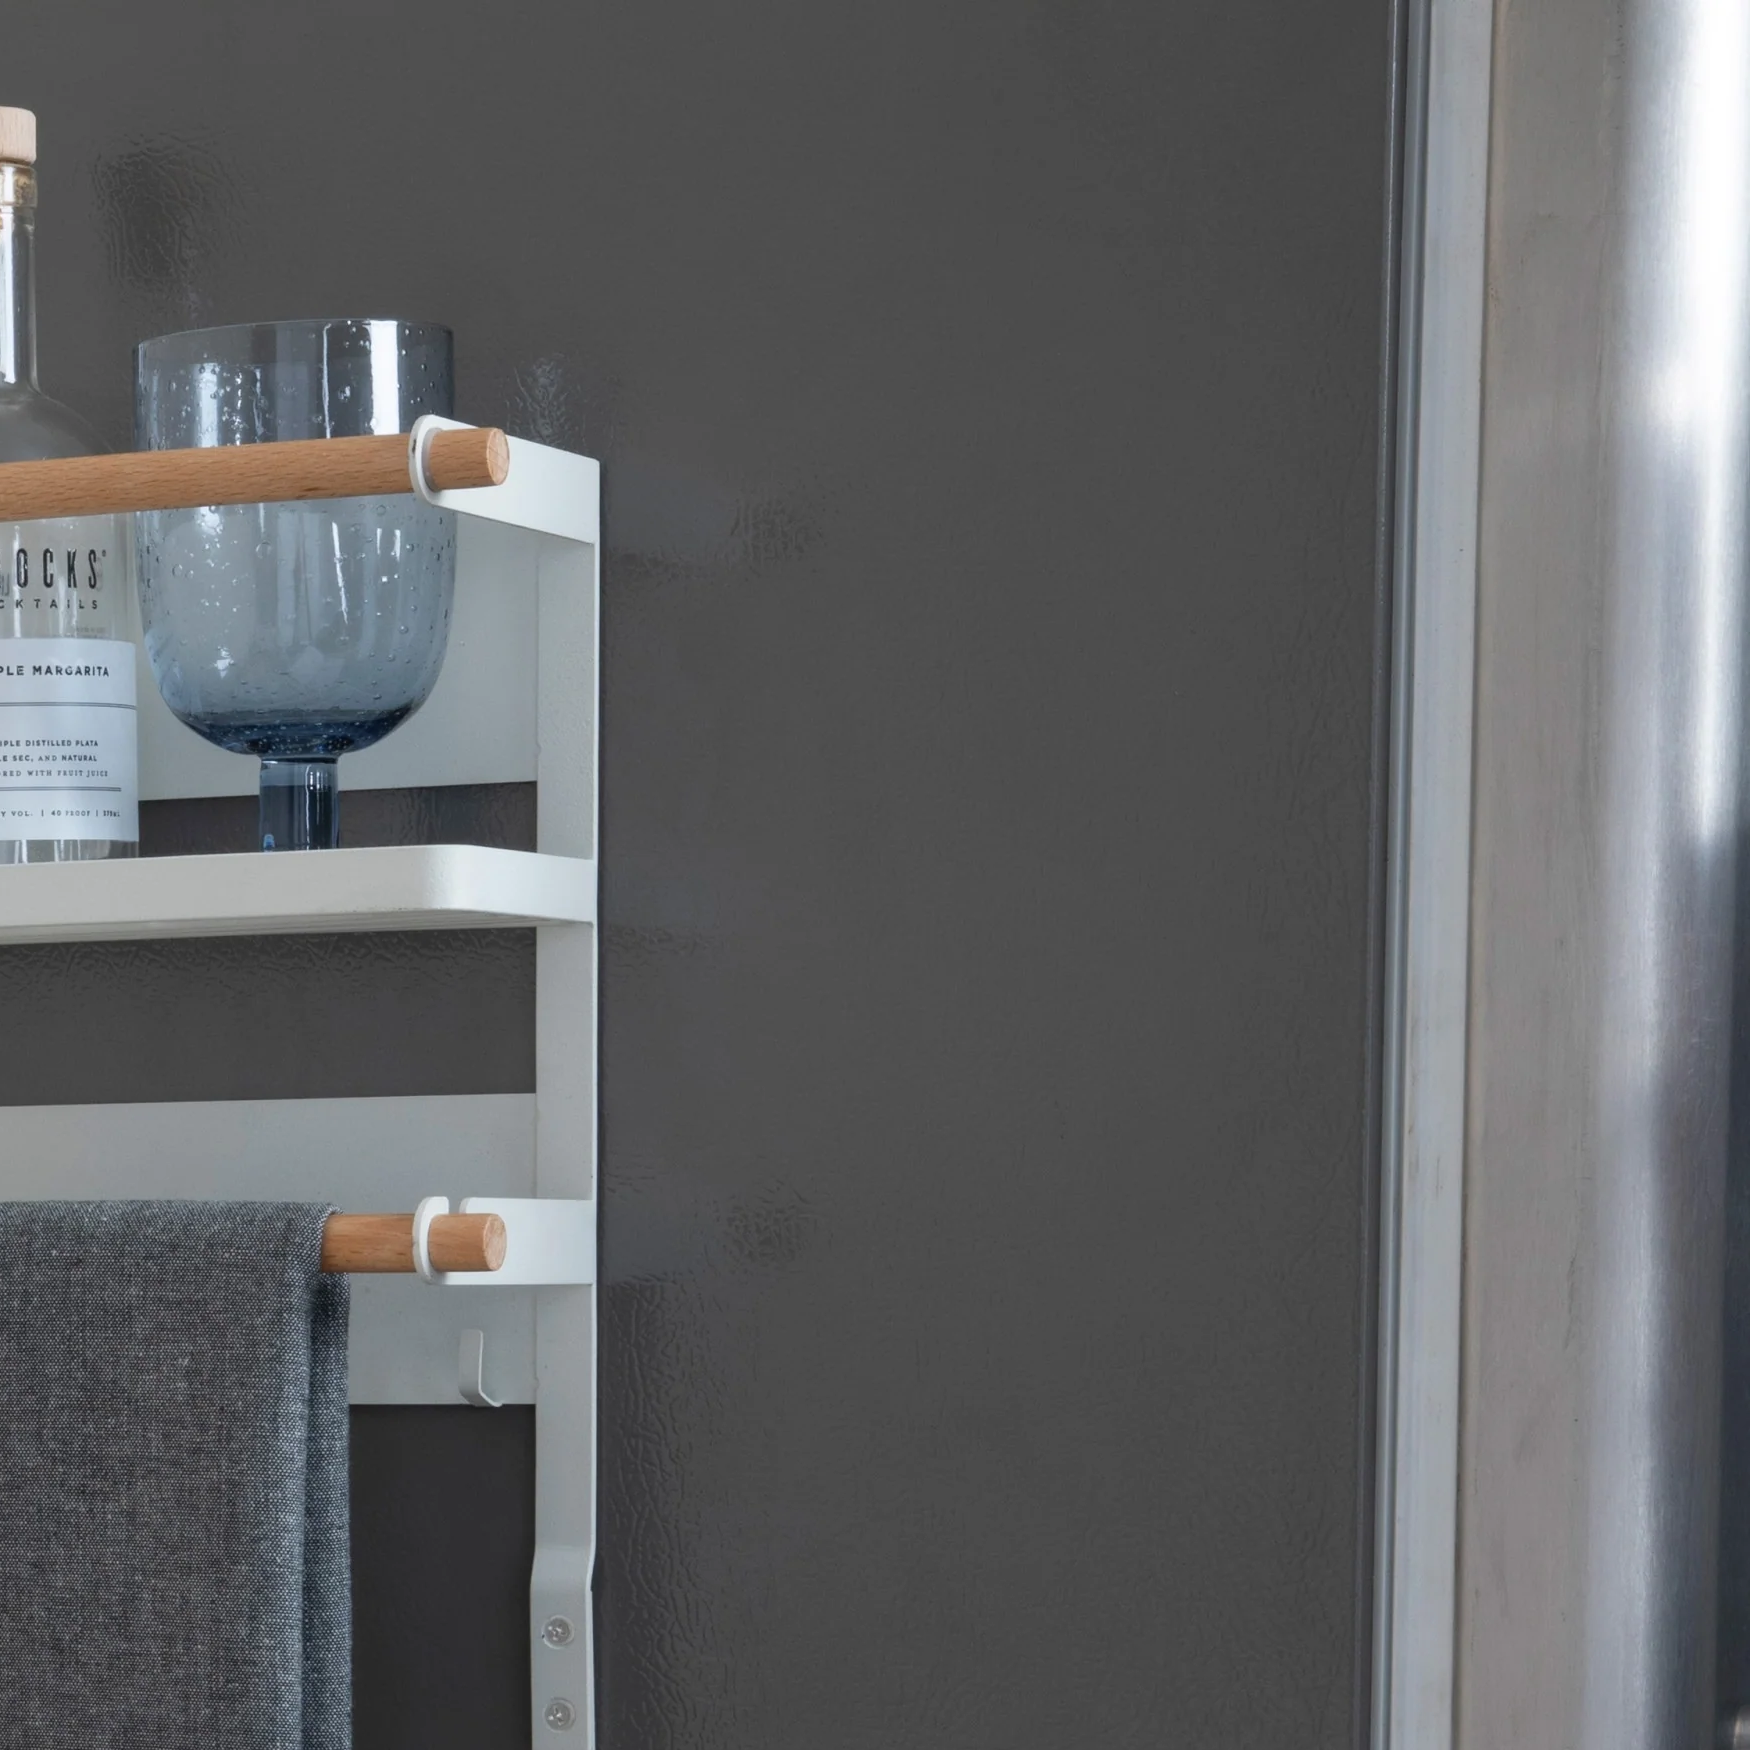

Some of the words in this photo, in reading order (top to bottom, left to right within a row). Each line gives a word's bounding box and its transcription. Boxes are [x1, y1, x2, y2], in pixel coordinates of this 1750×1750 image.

[32, 665, 110, 676] MARGARITA
[75, 739, 98, 747] PLATA
[57, 769, 83, 777] FRUIT
[86, 770, 108, 778] JUICE
